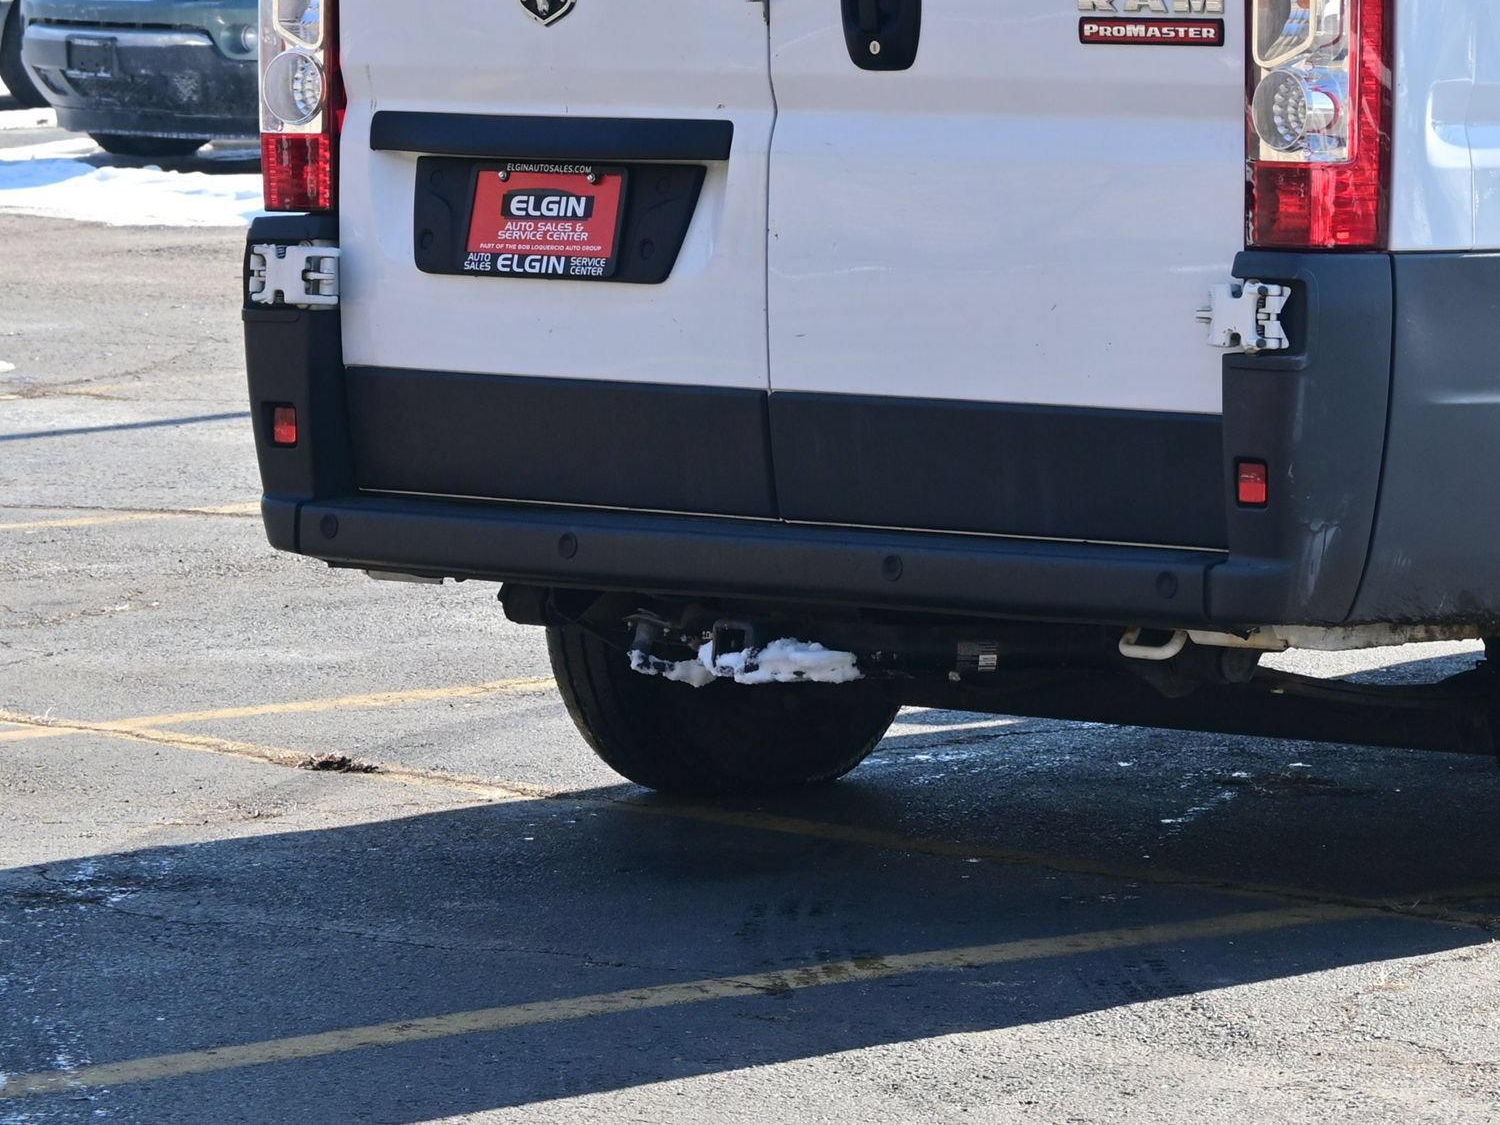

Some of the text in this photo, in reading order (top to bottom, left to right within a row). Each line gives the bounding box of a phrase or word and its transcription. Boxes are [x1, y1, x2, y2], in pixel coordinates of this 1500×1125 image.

[1083, 24, 1216, 39] PROMASTER
[506, 162, 592, 173] ELGINAUTOSALES.COM
[510, 195, 586, 217] ELGIN
[504, 221, 585, 232] AUTO SALES &
[497, 231, 589, 241] SERVICE CENTER
[467, 252, 491, 262] AUTO
[570, 257, 607, 268] SERVICE
[463, 261, 491, 271] SALES
[496, 253, 566, 274] ELGIN
[569, 266, 604, 276] CENTER
